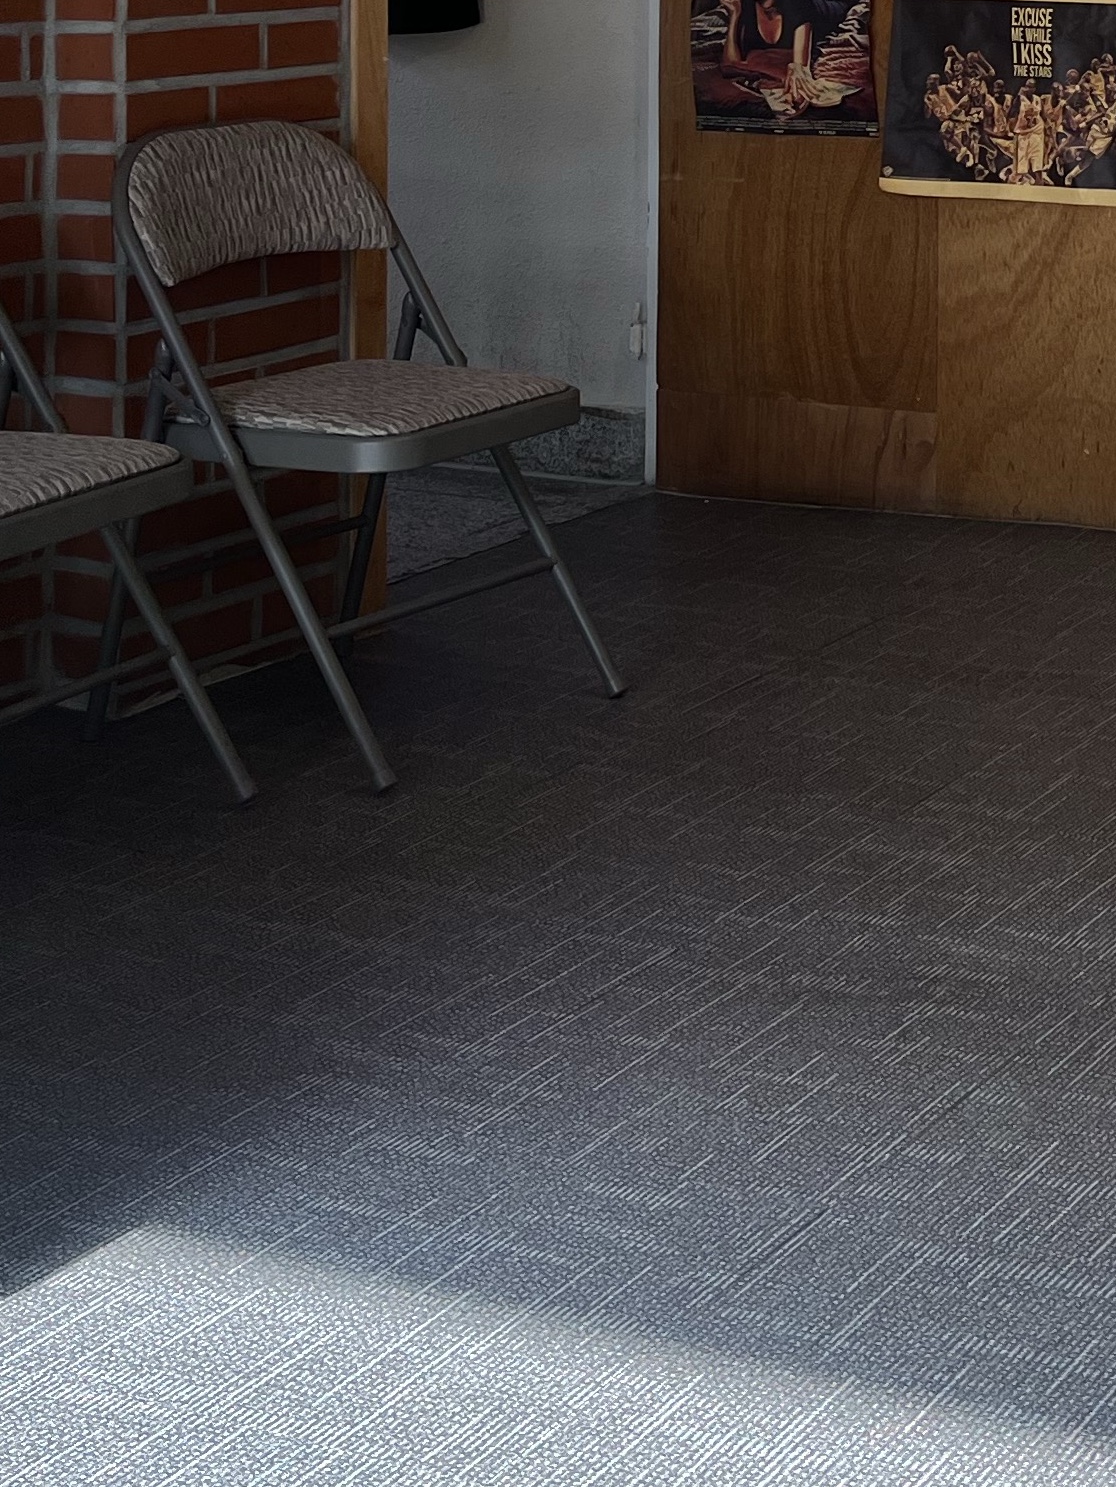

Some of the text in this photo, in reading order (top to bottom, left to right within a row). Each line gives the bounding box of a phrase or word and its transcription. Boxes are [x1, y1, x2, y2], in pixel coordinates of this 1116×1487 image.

[1011, 6, 1054, 27] EXCUSE
[1011, 27, 1052, 43] ME WHILE
[1012, 42, 1052, 66] I KISS
[1013, 64, 1052, 79] THE STARS
